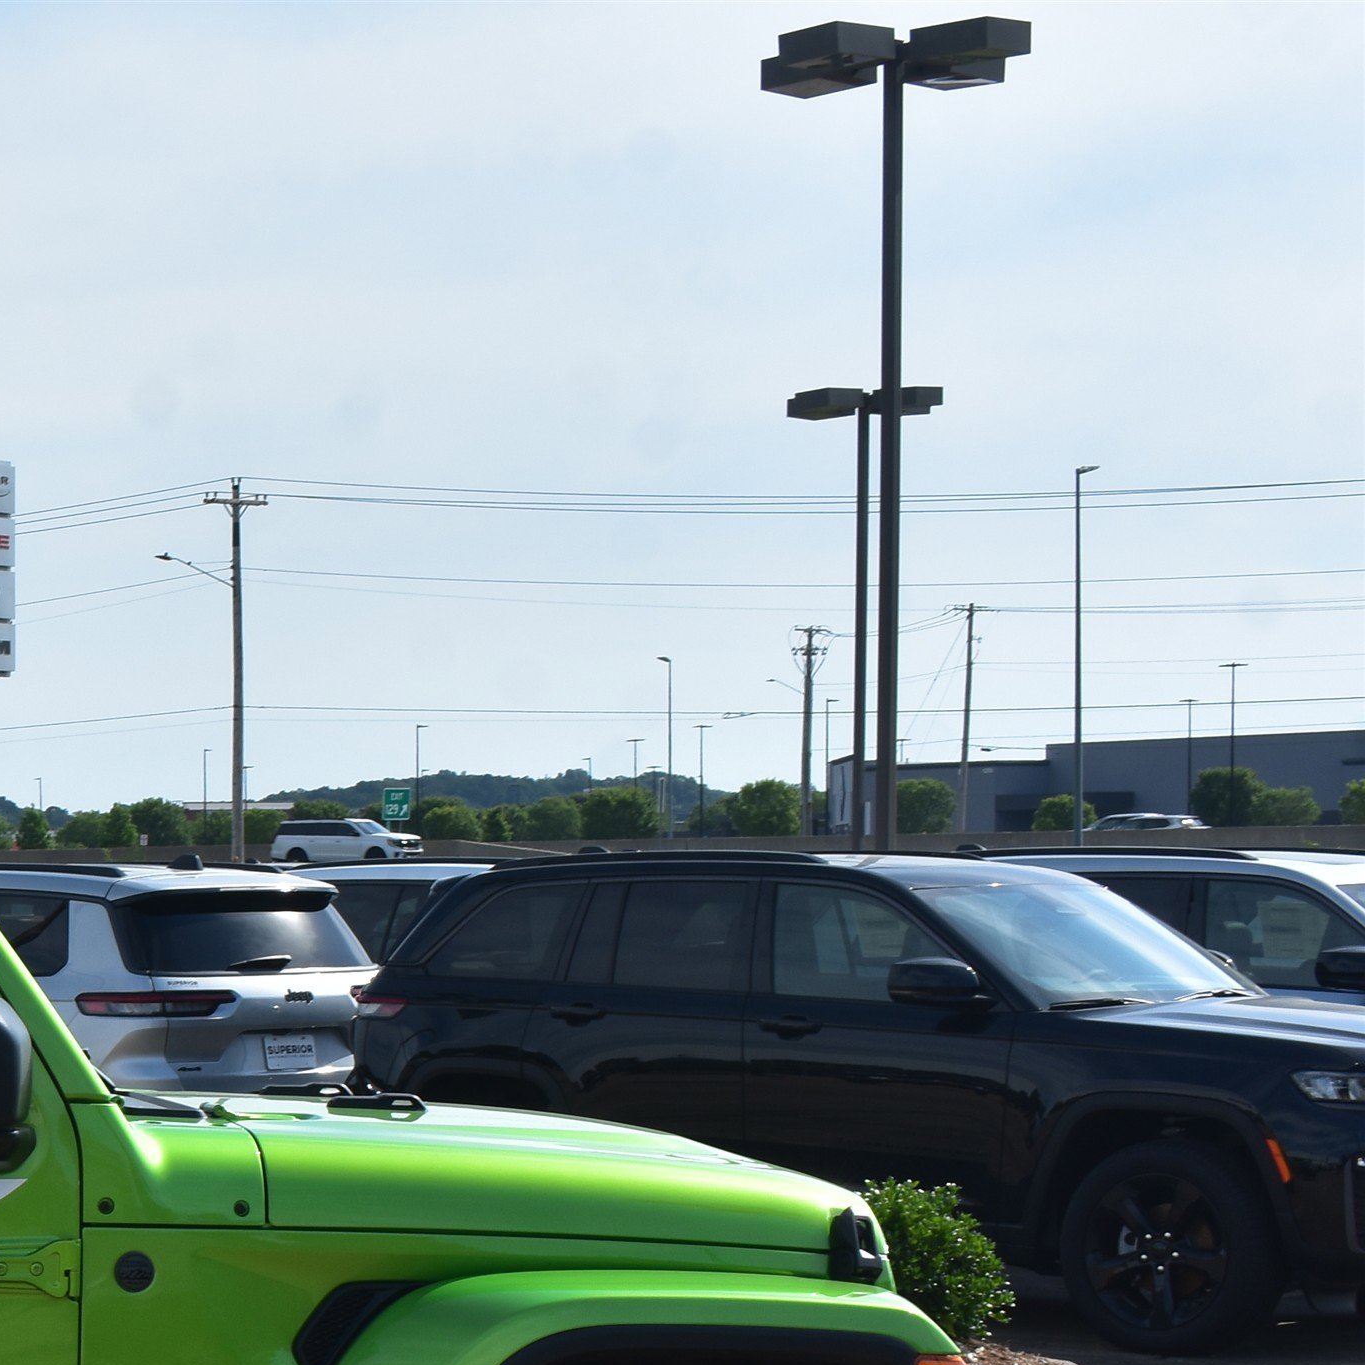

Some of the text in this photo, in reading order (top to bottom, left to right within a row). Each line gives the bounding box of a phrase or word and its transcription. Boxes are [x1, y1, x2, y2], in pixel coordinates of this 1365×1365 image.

[390, 793, 404, 801] EXIT
[385, 804, 399, 815] 129
[285, 989, 314, 1004] Jeep
[267, 1044, 314, 1055] SUPERIOR
